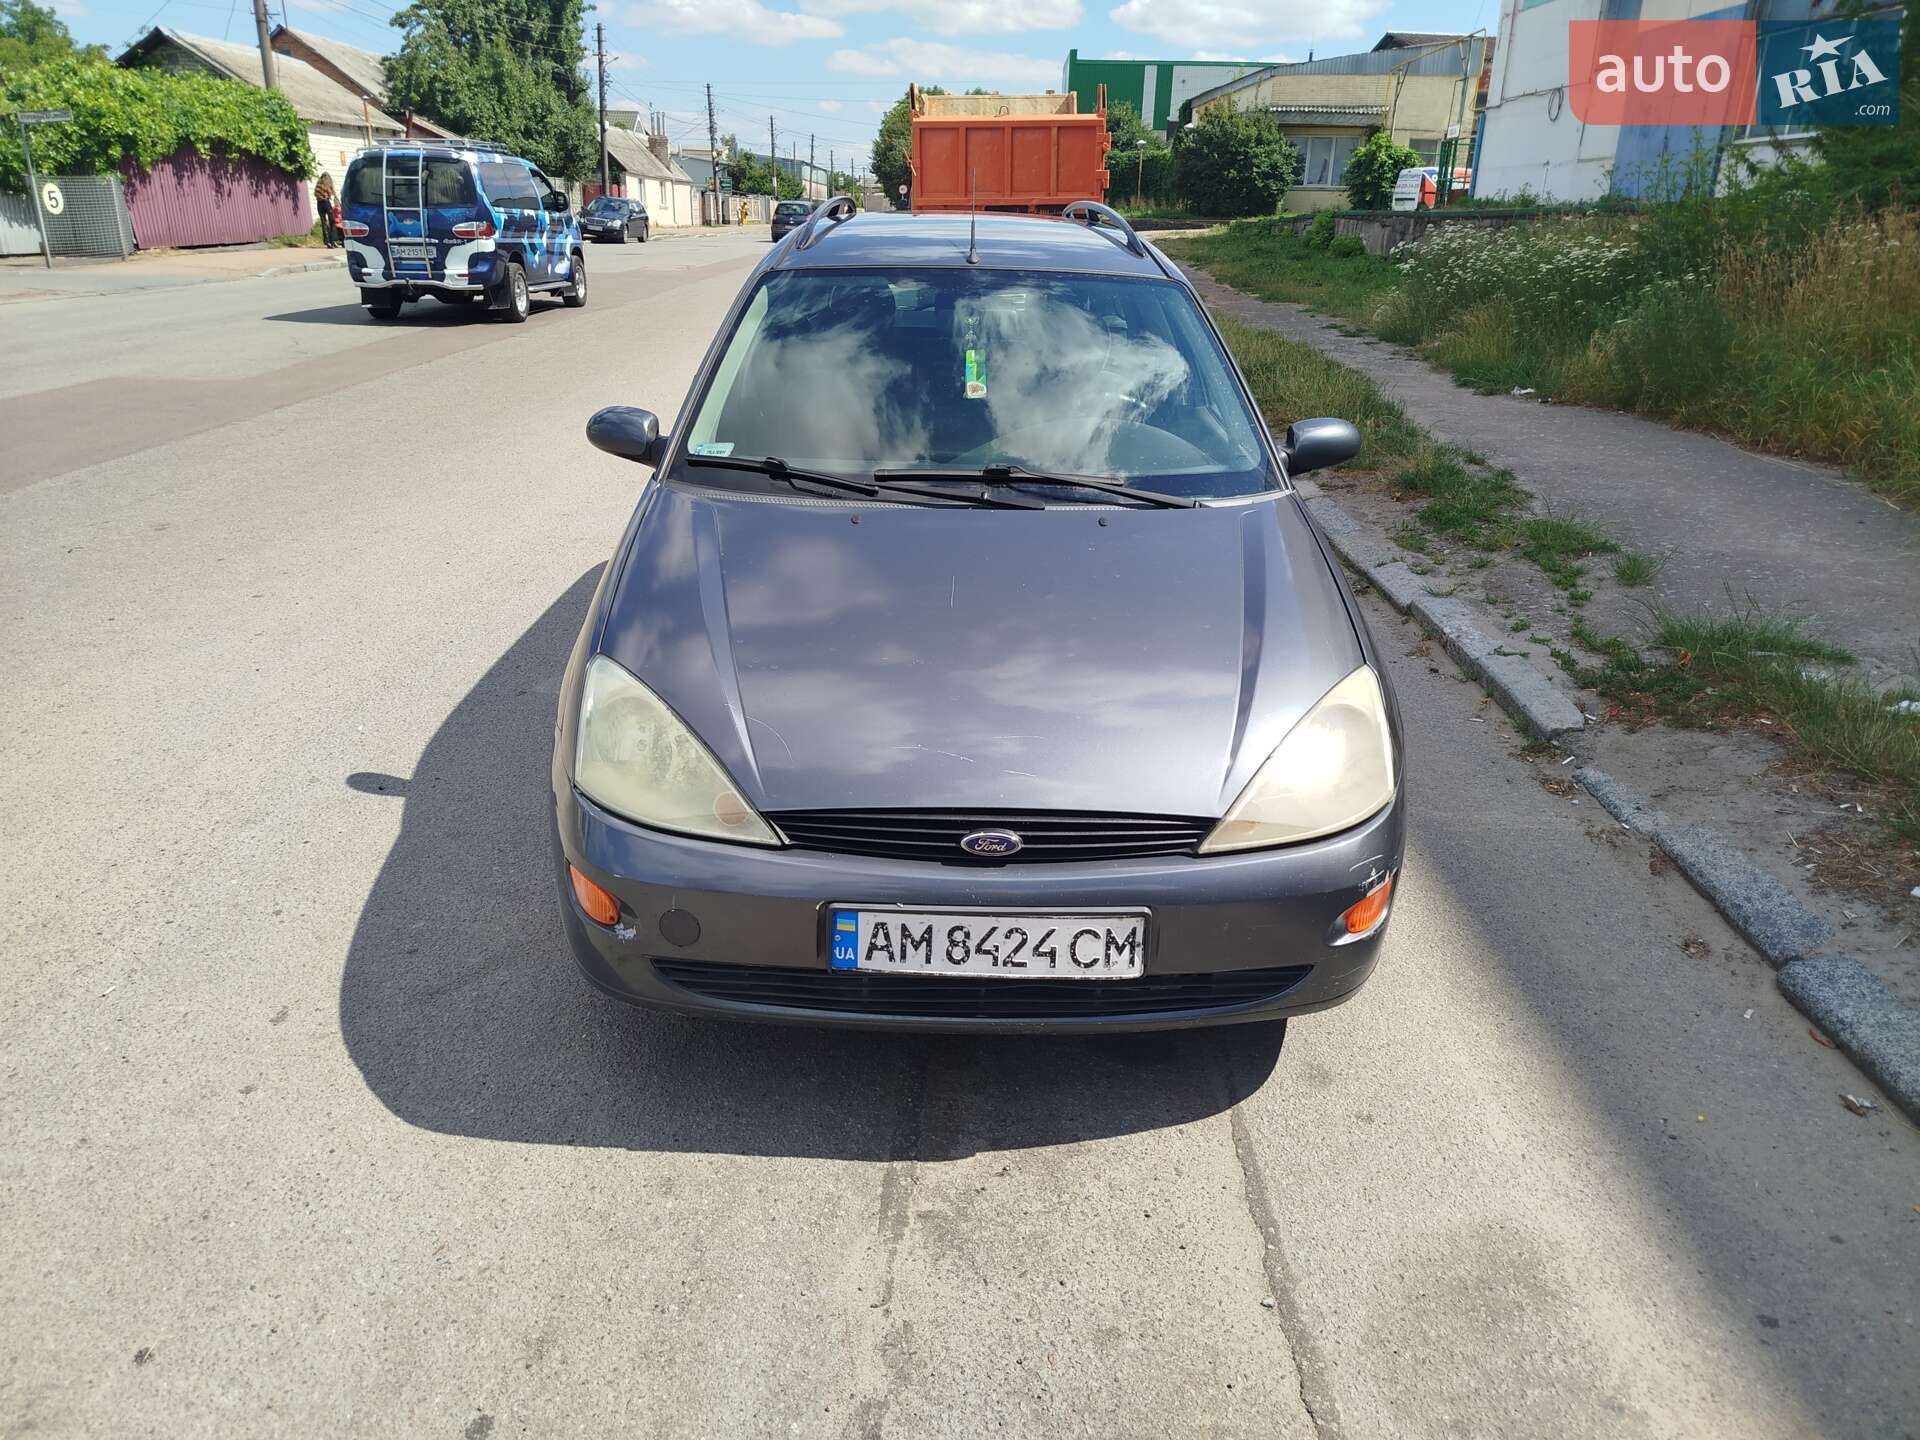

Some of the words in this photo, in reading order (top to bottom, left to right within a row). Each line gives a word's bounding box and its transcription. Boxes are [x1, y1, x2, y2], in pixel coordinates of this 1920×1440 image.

[48, 191, 59, 208] 5
[974, 838, 1008, 852] Ford
[864, 921, 934, 965] AM
[945, 924, 1058, 969] 8424
[1068, 925, 1138, 969] CM
[835, 947, 856, 961] UA
